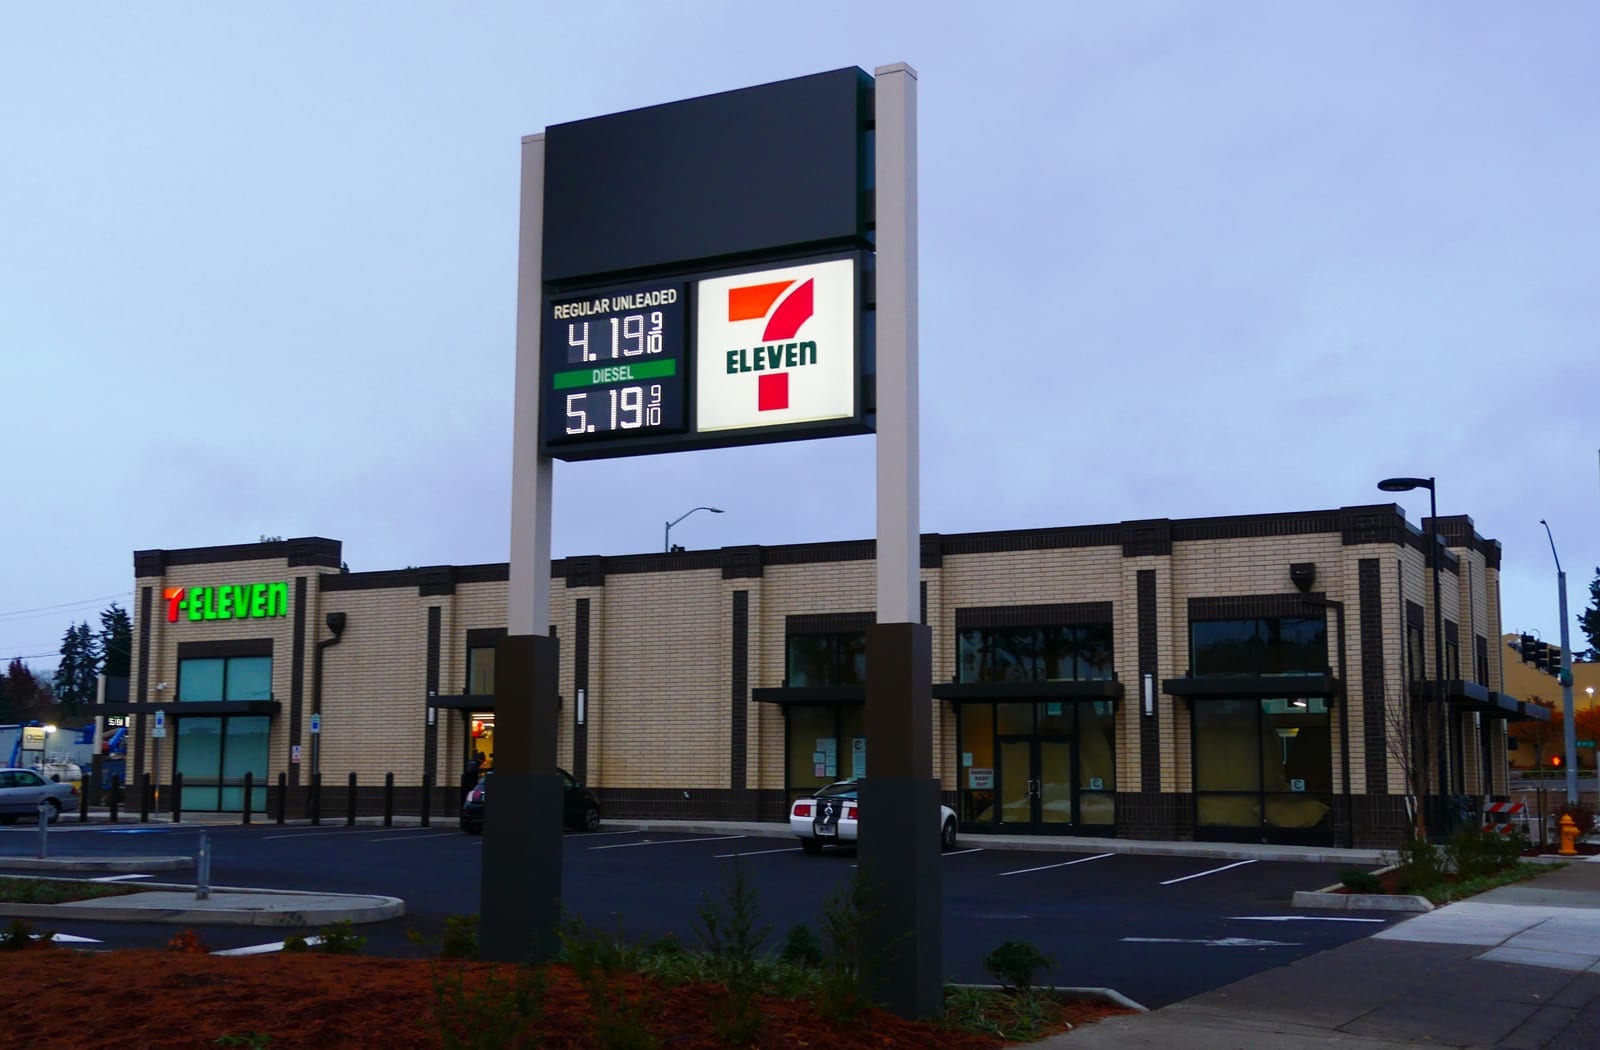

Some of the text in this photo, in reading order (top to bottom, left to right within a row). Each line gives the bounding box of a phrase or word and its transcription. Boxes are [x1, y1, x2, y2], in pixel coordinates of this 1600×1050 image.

[554, 289, 677, 319] REGULAR UNLEADED
[728, 277, 814, 412] 7
[592, 366, 634, 384] DIESEL
